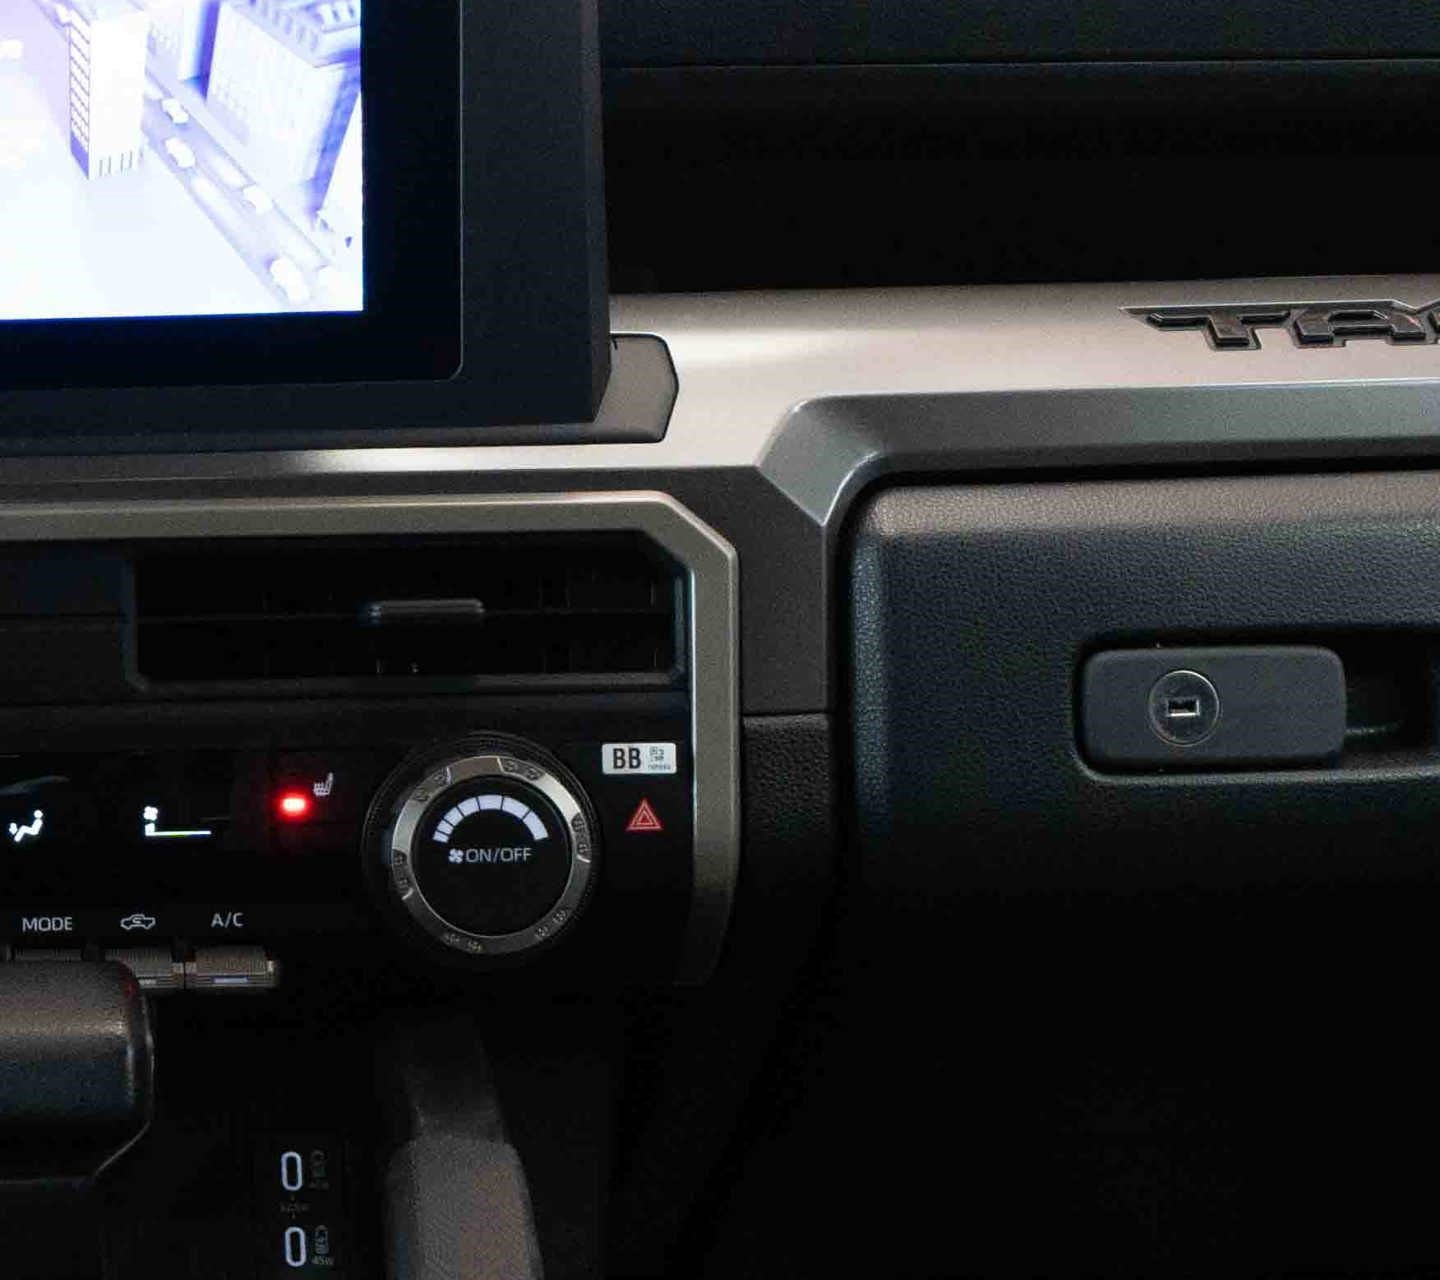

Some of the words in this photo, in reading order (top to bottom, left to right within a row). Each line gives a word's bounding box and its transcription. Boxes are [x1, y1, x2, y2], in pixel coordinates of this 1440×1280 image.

[612, 747, 642, 770] BB
[465, 846, 533, 864] ON/OFF
[21, 916, 73, 933] MODE
[210, 911, 245, 928] A/C
